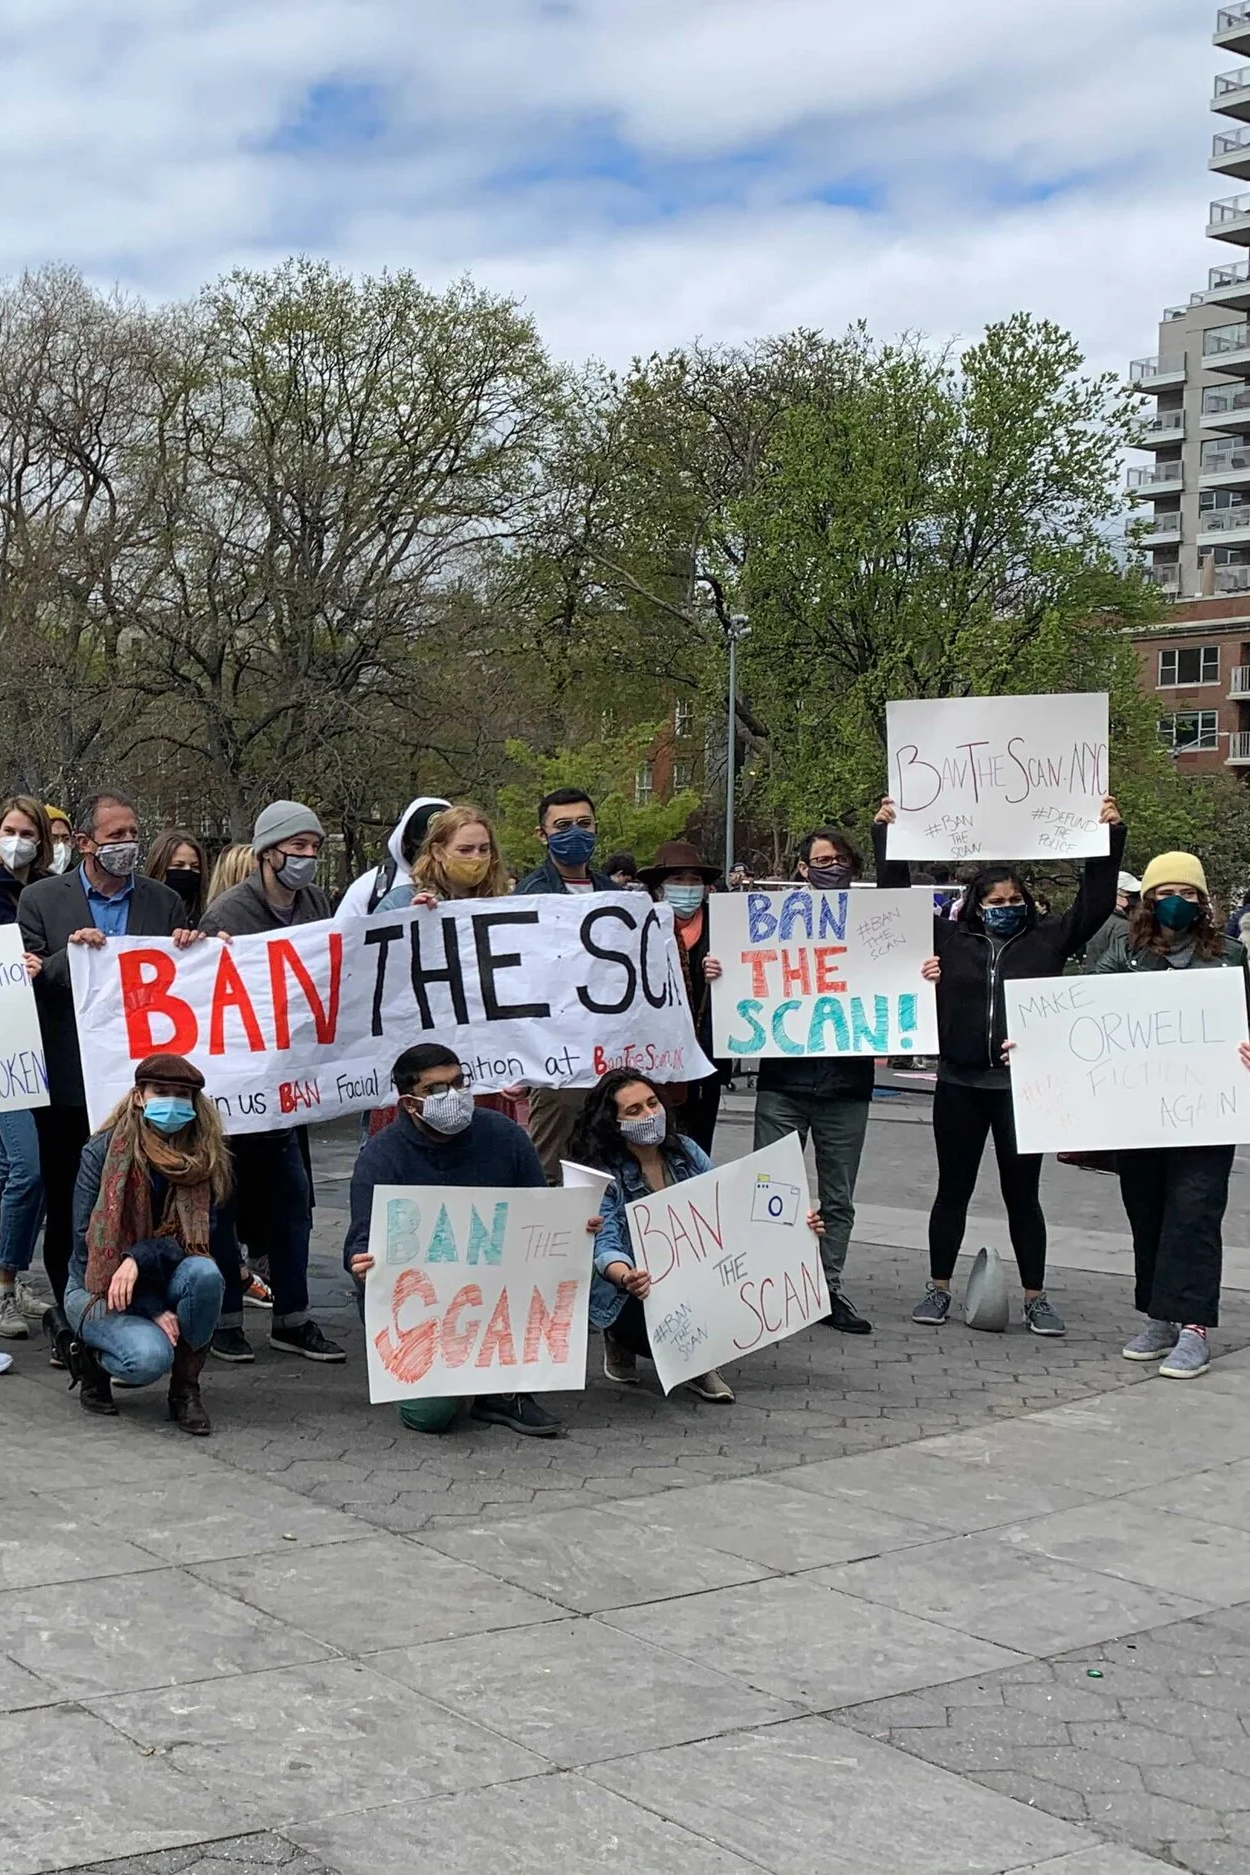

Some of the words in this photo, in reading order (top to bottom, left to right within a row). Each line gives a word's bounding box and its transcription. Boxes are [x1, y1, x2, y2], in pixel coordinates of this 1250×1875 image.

[924, 814, 973, 838] #BAN
[951, 842, 981, 859] SCAN
[748, 891, 848, 943] BAN
[118, 933, 342, 1059] BAN
[364, 911, 551, 1036] THE
[741, 946, 848, 998] THE
[728, 993, 918, 1055] SCAN!
[1018, 981, 1094, 1028] MAKE
[1069, 1009, 1226, 1062] ORWELL
[239, 1092, 266, 1115] us
[278, 1078, 321, 1113] BAN
[336, 1069, 379, 1103] Facial
[545, 1046, 580, 1075] at
[1160, 1086, 1237, 1128] AGAIN
[386, 1199, 509, 1265] BAN
[521, 1225, 571, 1262] THE
[633, 1181, 723, 1284] BAN
[713, 1252, 749, 1287] THE
[733, 1246, 822, 1350] SCAN
